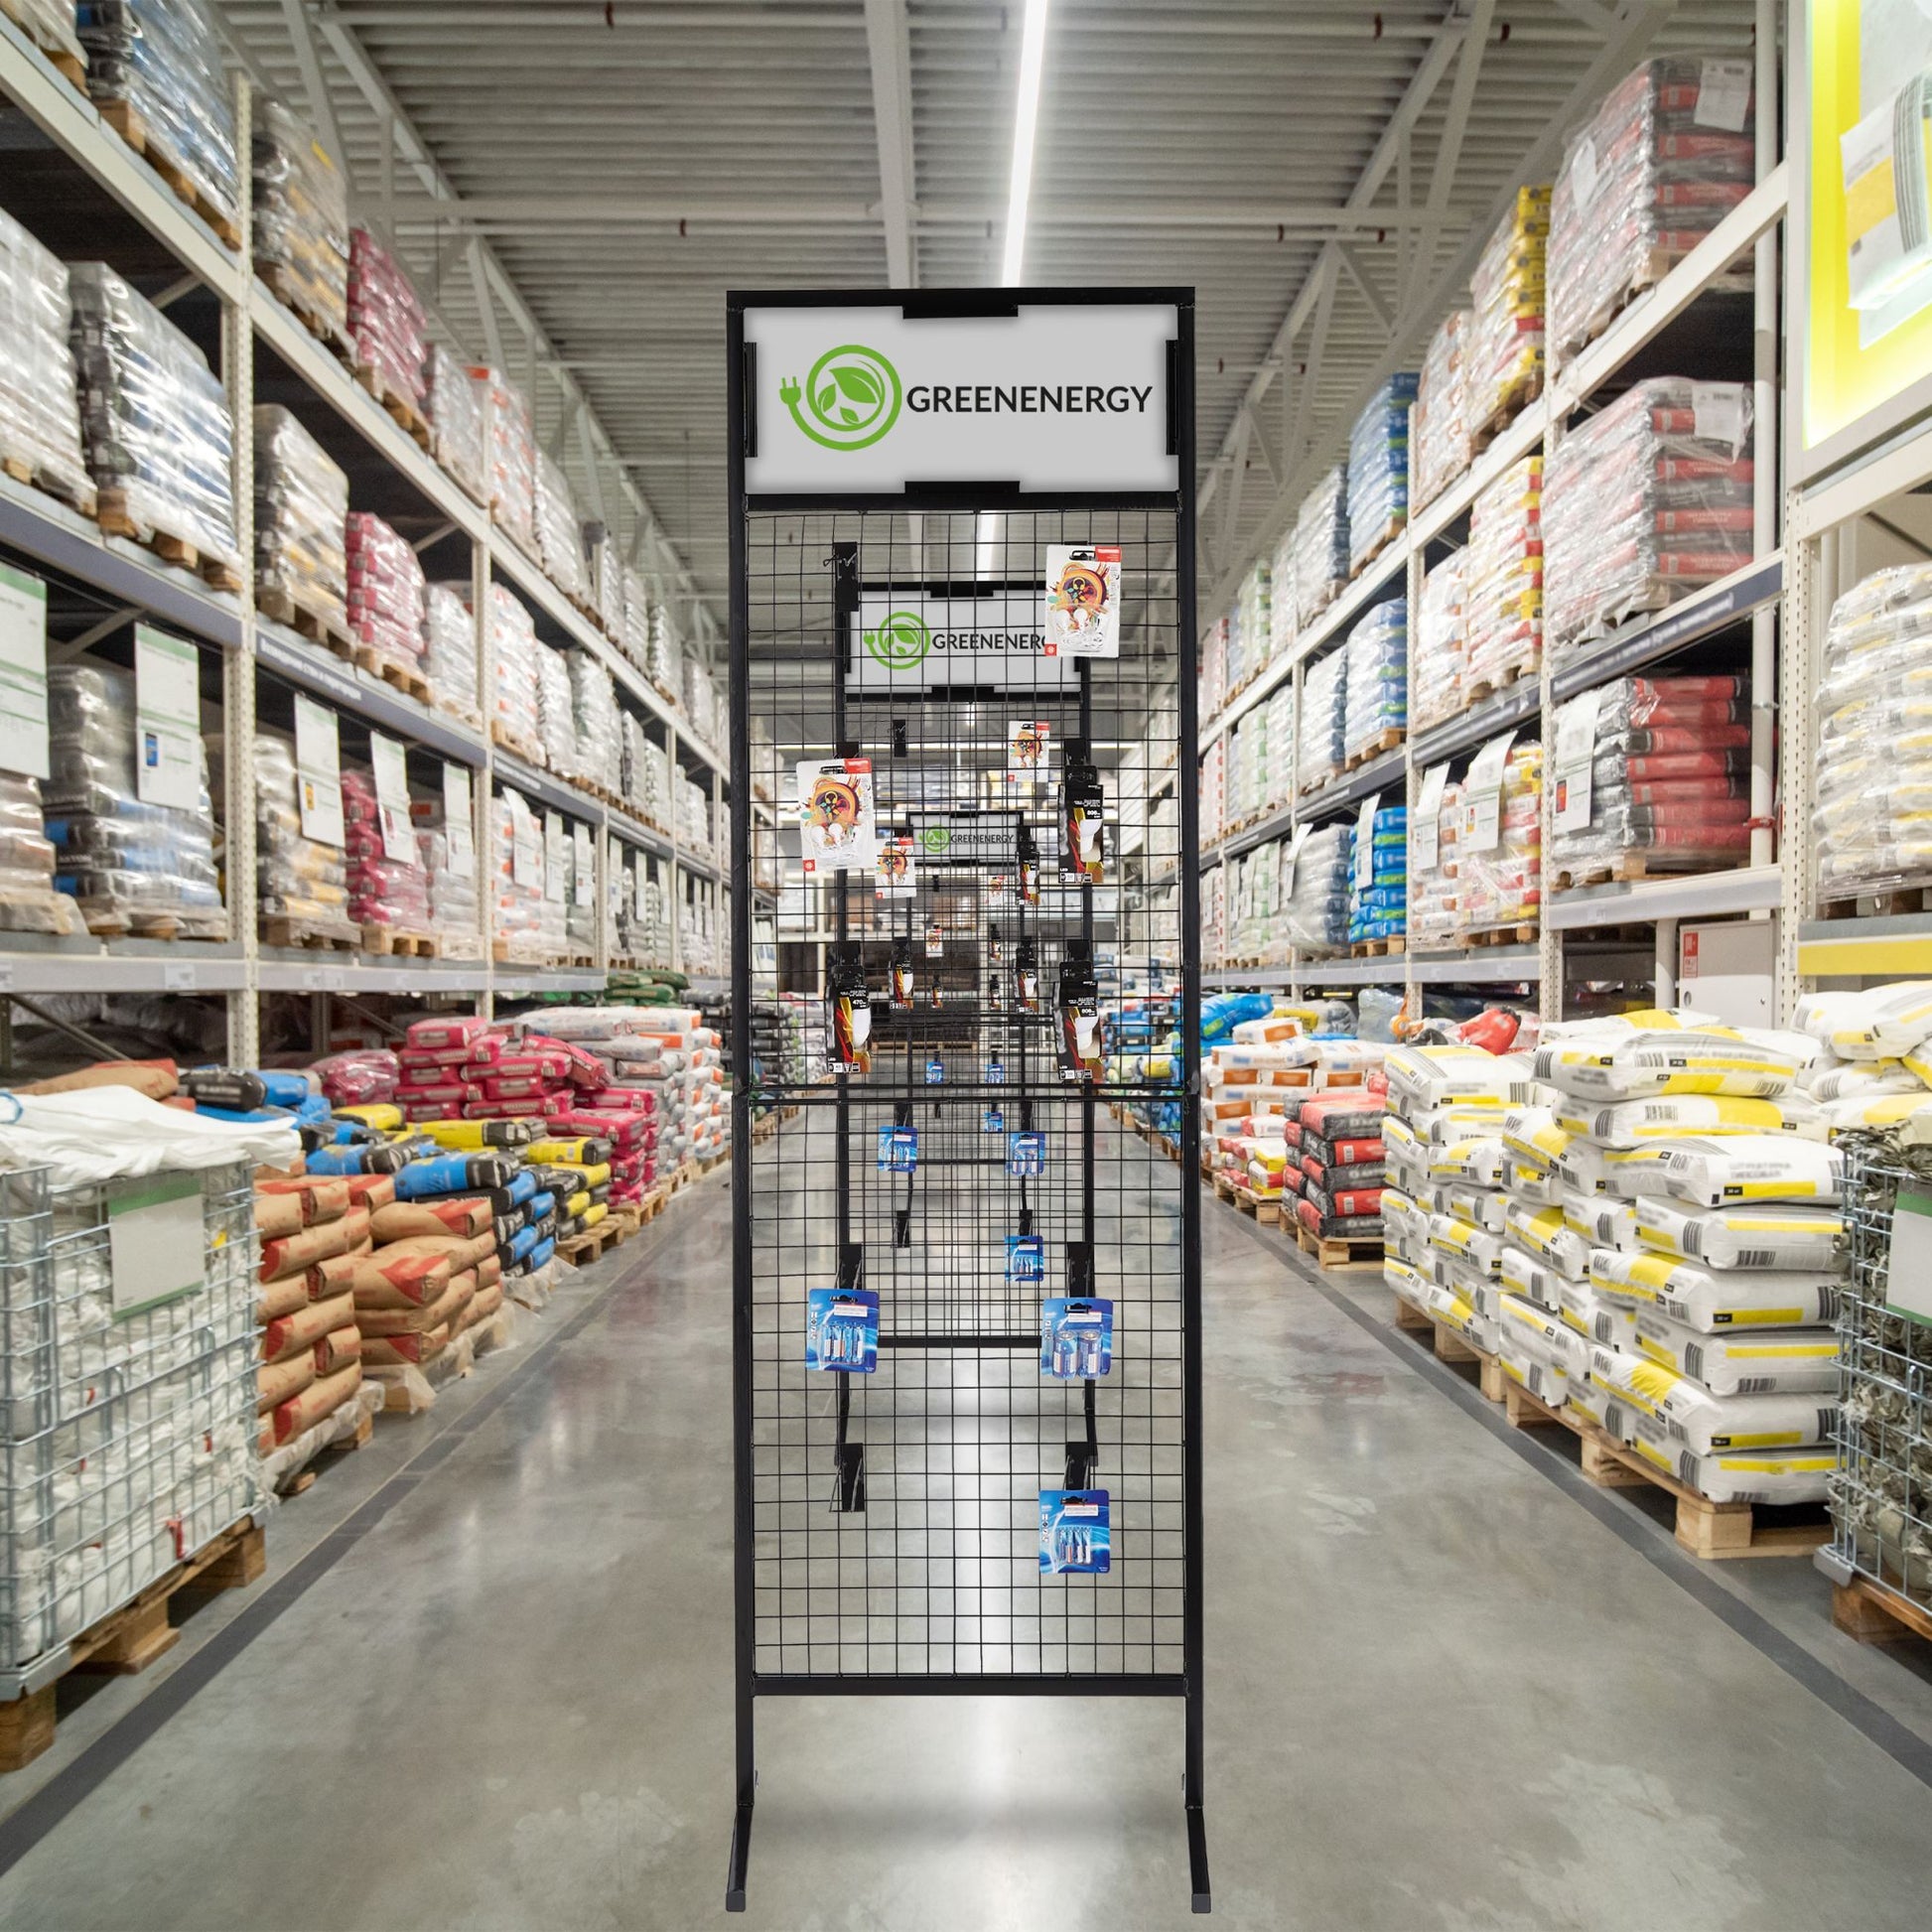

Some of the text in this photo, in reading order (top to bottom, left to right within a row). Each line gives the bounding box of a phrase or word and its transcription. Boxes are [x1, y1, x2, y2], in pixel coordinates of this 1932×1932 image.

[906, 385, 1153, 413] GREENENERGY
[932, 633, 1045, 650] GREENENER
[950, 834, 1014, 844] GREENENERGY
